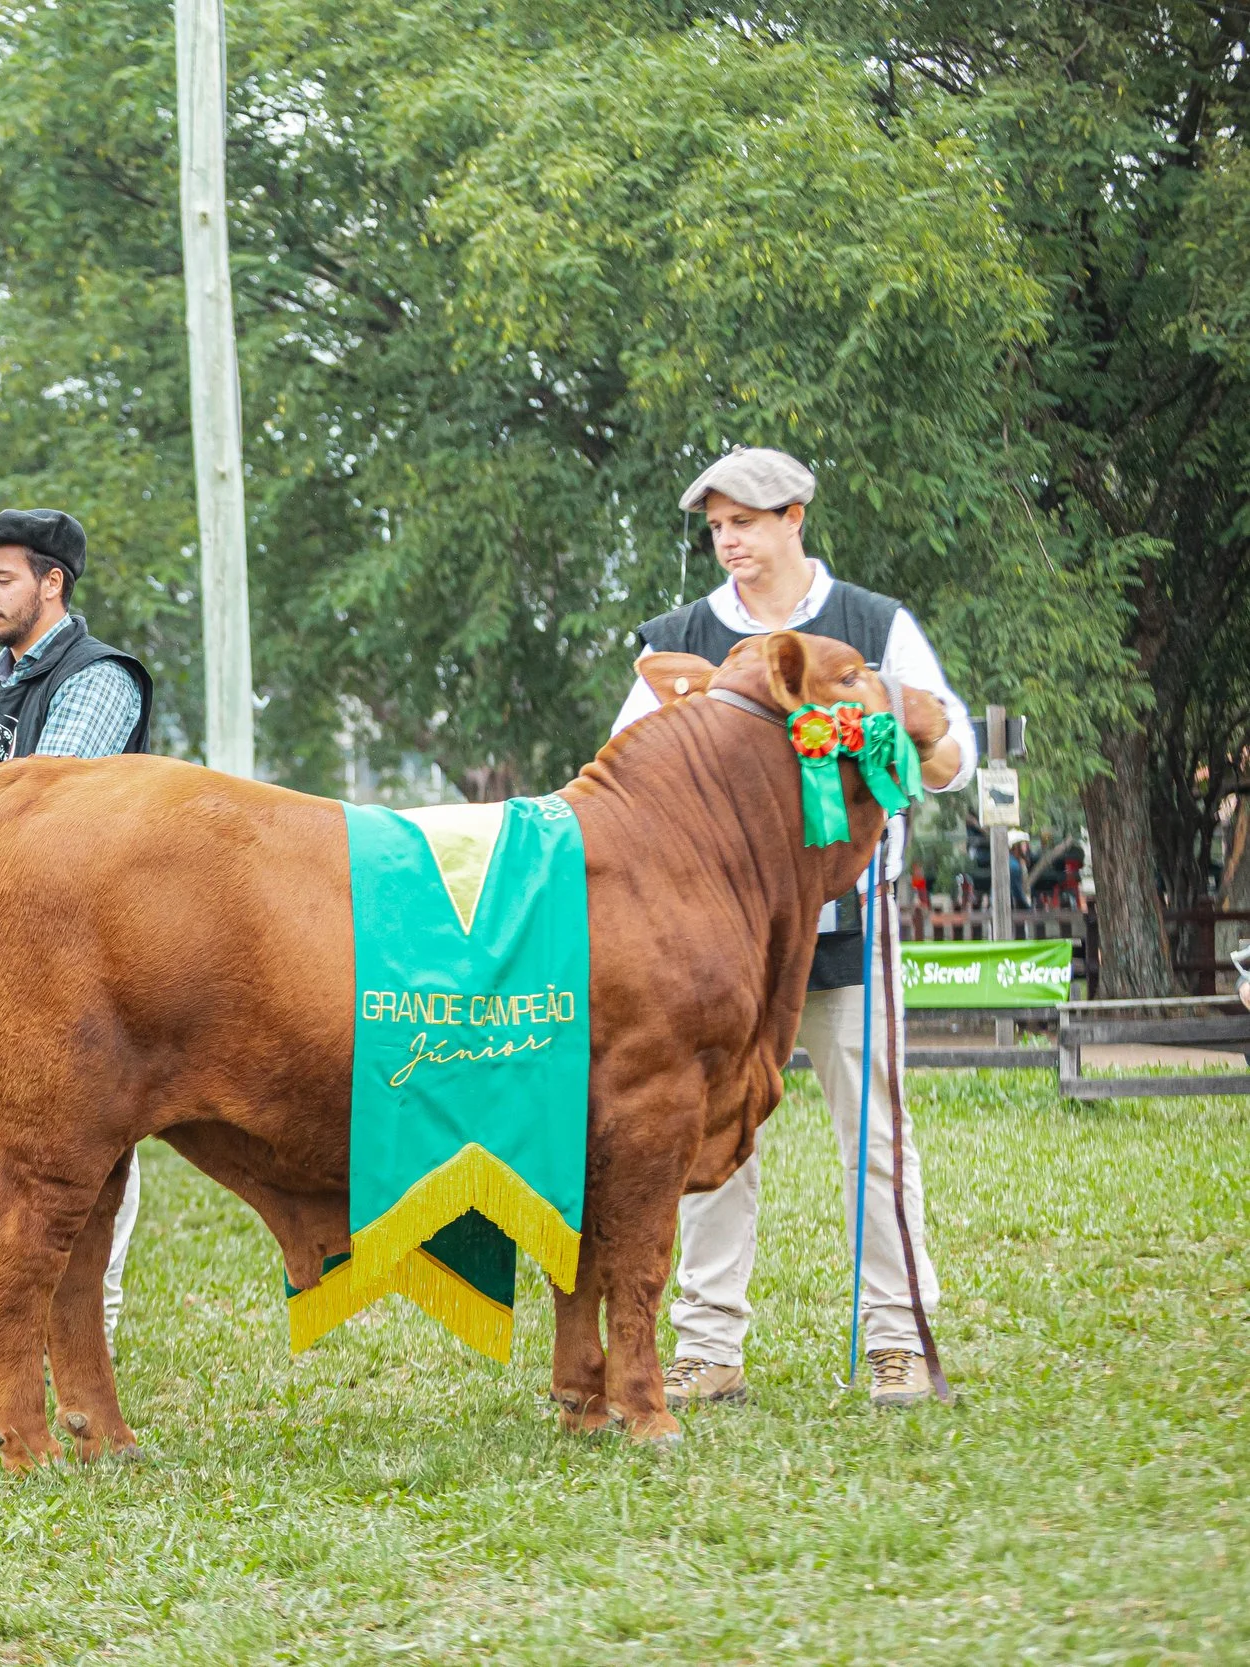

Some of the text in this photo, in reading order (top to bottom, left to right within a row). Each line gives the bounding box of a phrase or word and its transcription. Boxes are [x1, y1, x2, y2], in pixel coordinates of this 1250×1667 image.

[922, 961, 982, 985] Sicredi
[1018, 961, 1072, 985] Sicred
[362, 984, 576, 1027] GRANDE CAMPEÃO
[389, 1031, 552, 1088] Júnior
